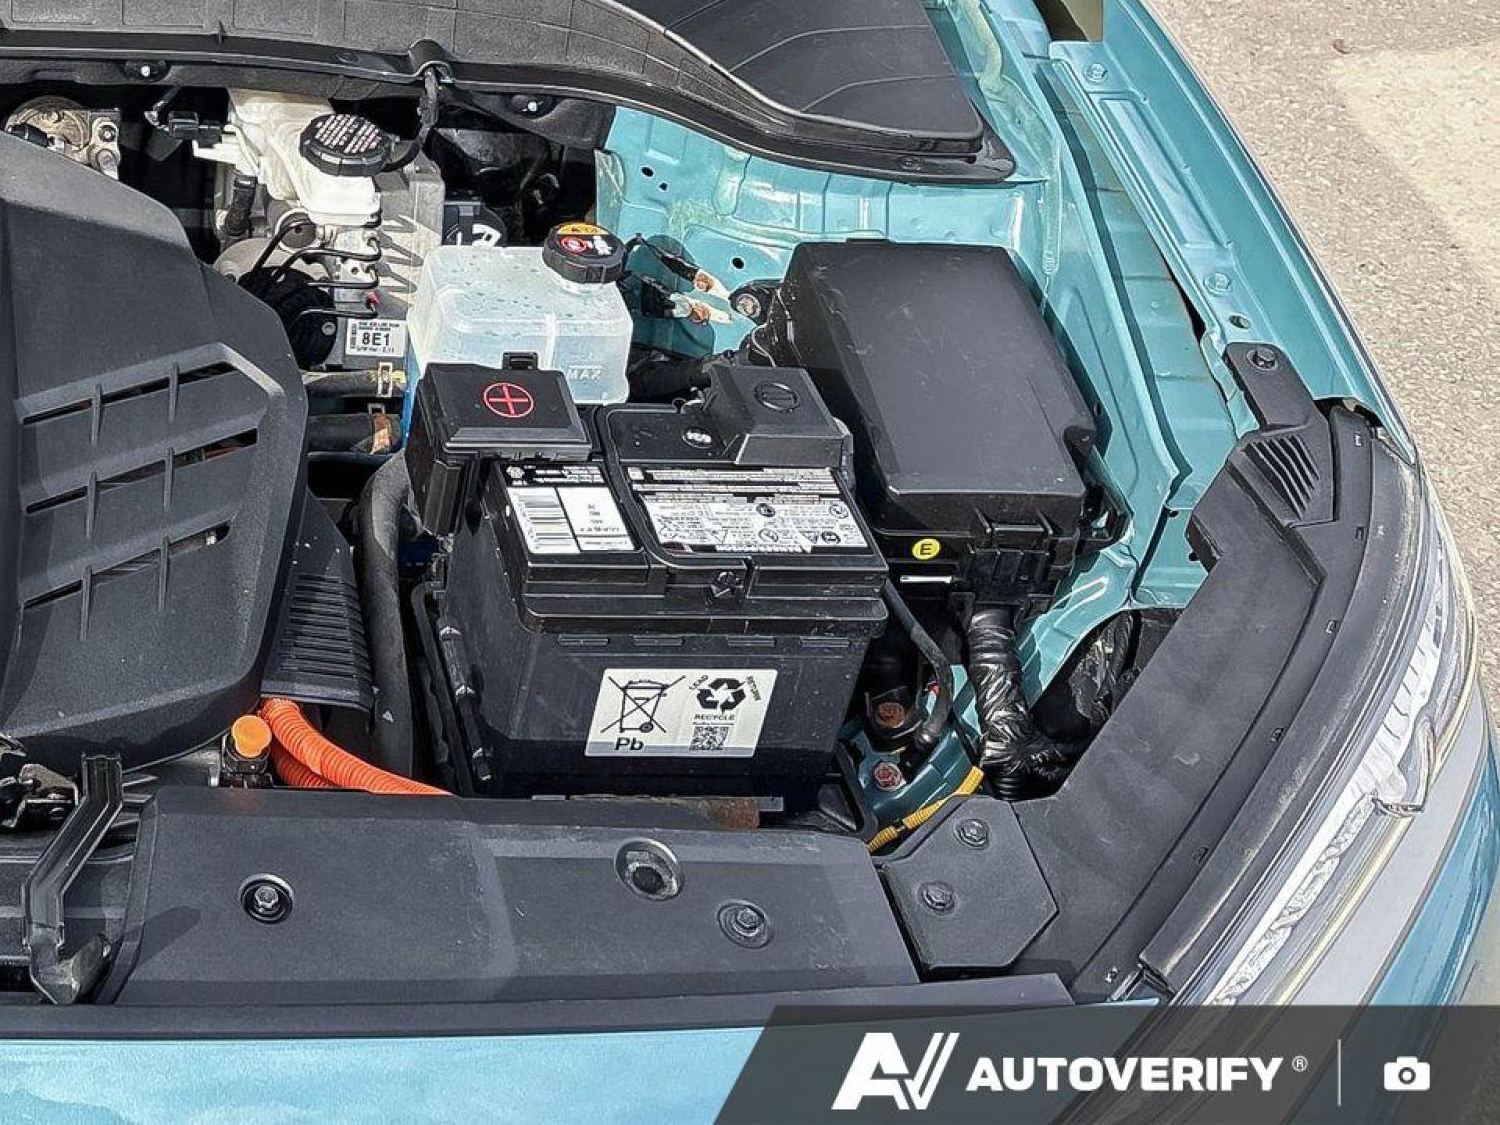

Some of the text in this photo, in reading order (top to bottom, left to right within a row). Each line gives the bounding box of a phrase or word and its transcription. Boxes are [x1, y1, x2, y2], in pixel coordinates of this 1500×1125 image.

[362, 332, 390, 346] 8E1
[566, 369, 602, 381] MAX
[920, 543, 933, 555] E
[693, 713, 736, 721] RECYCLE
[614, 737, 645, 751] Pb
